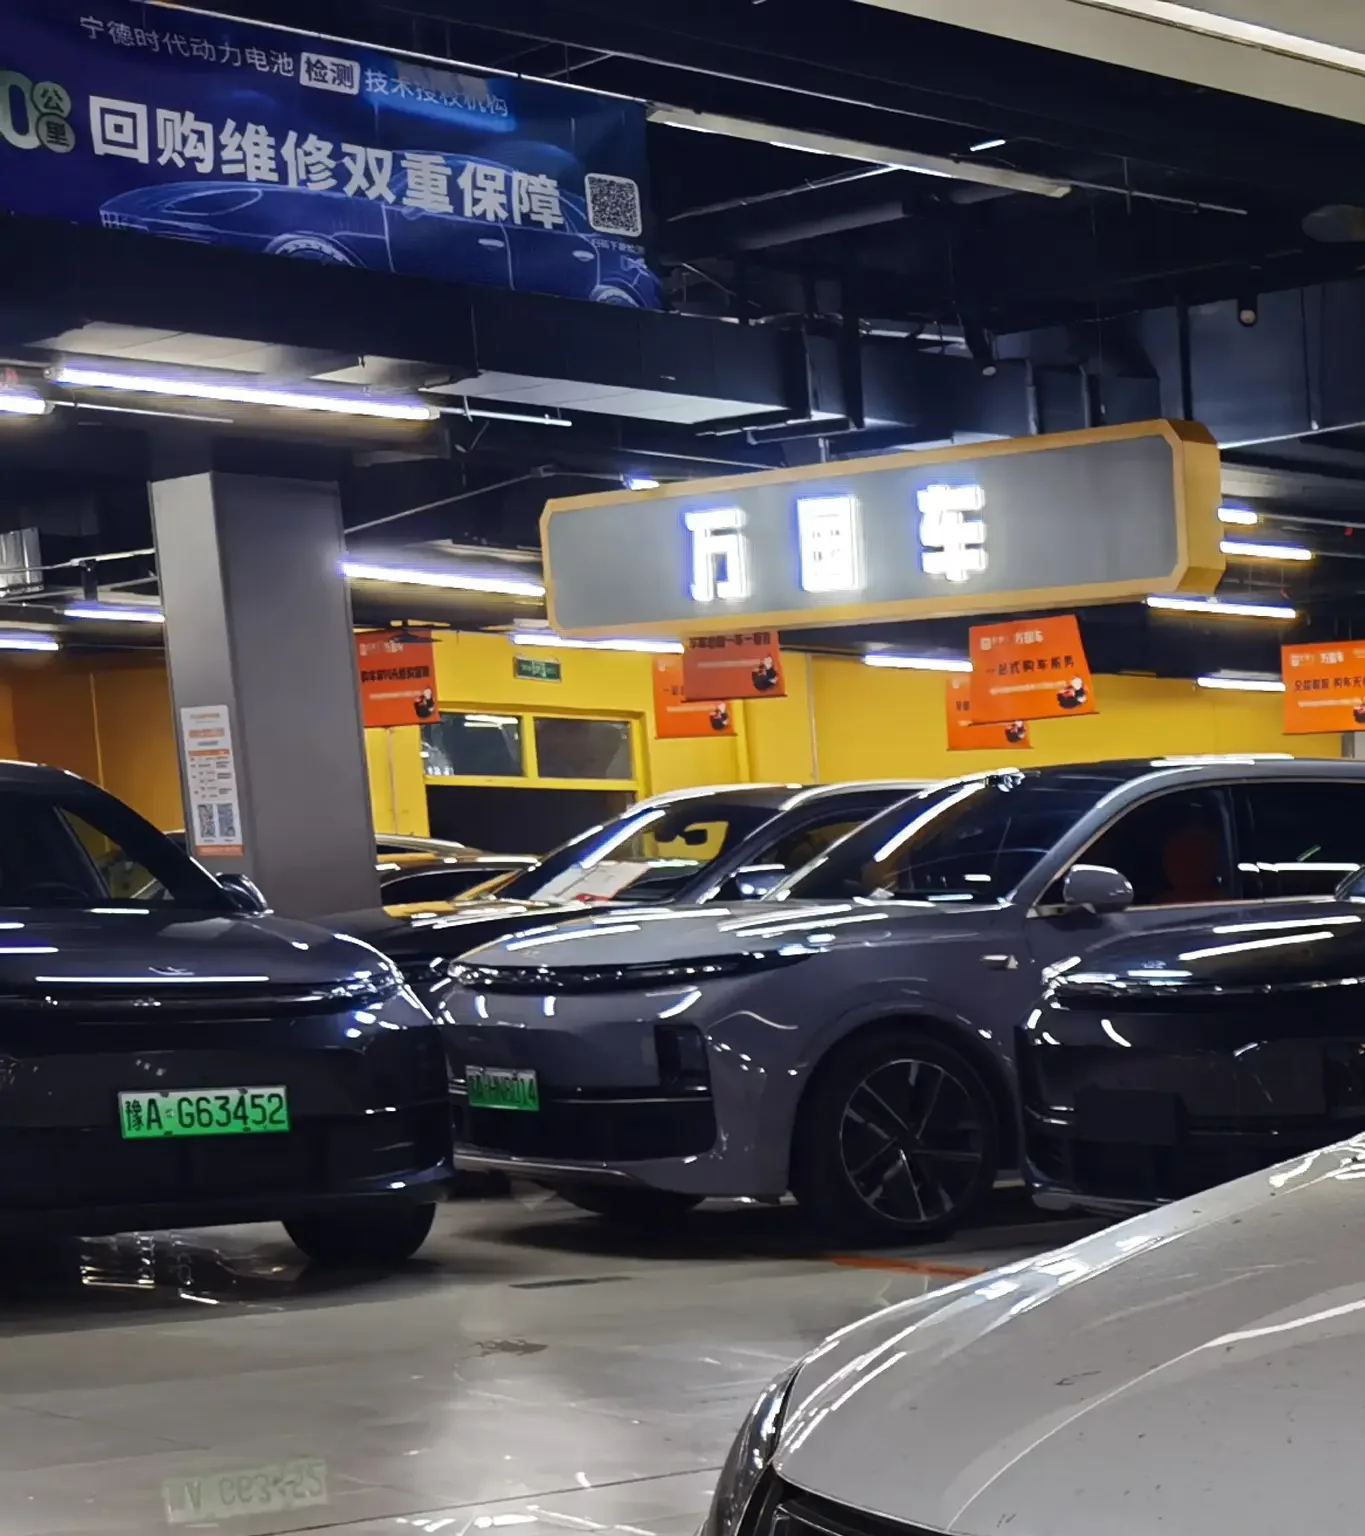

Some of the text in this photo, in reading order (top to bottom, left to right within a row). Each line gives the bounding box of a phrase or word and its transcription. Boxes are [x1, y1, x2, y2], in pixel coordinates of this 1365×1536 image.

[89, 95, 564, 230] 回购维修双重保障
